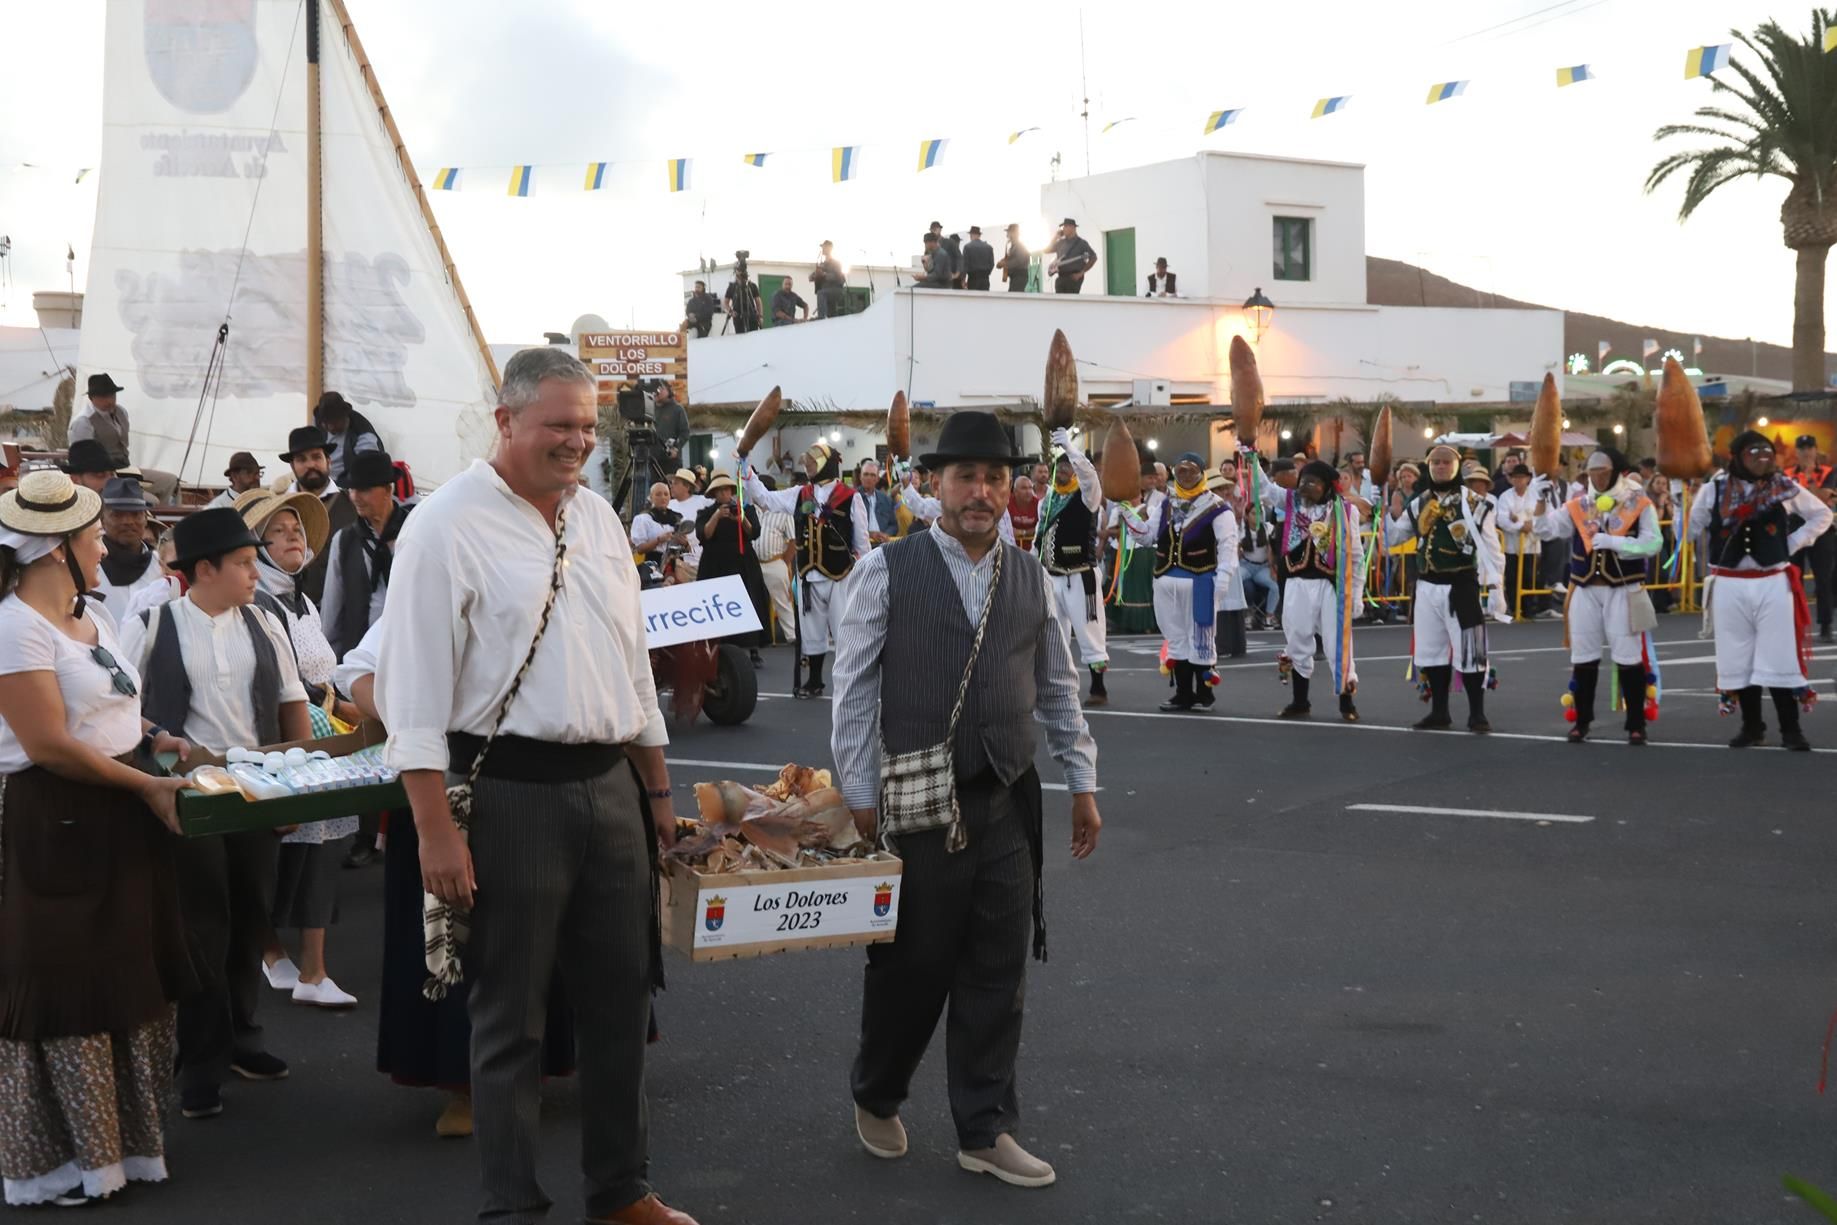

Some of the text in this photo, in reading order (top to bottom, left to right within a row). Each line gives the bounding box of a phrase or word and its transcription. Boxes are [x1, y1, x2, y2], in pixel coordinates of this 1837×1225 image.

[588, 334, 678, 346] VENTORRILLO
[619, 349, 646, 360] LOS
[600, 363, 663, 374] DOLORES
[646, 594, 743, 633] rrecife
[753, 890, 849, 912] Los Dolores
[776, 911, 822, 931] 2023
